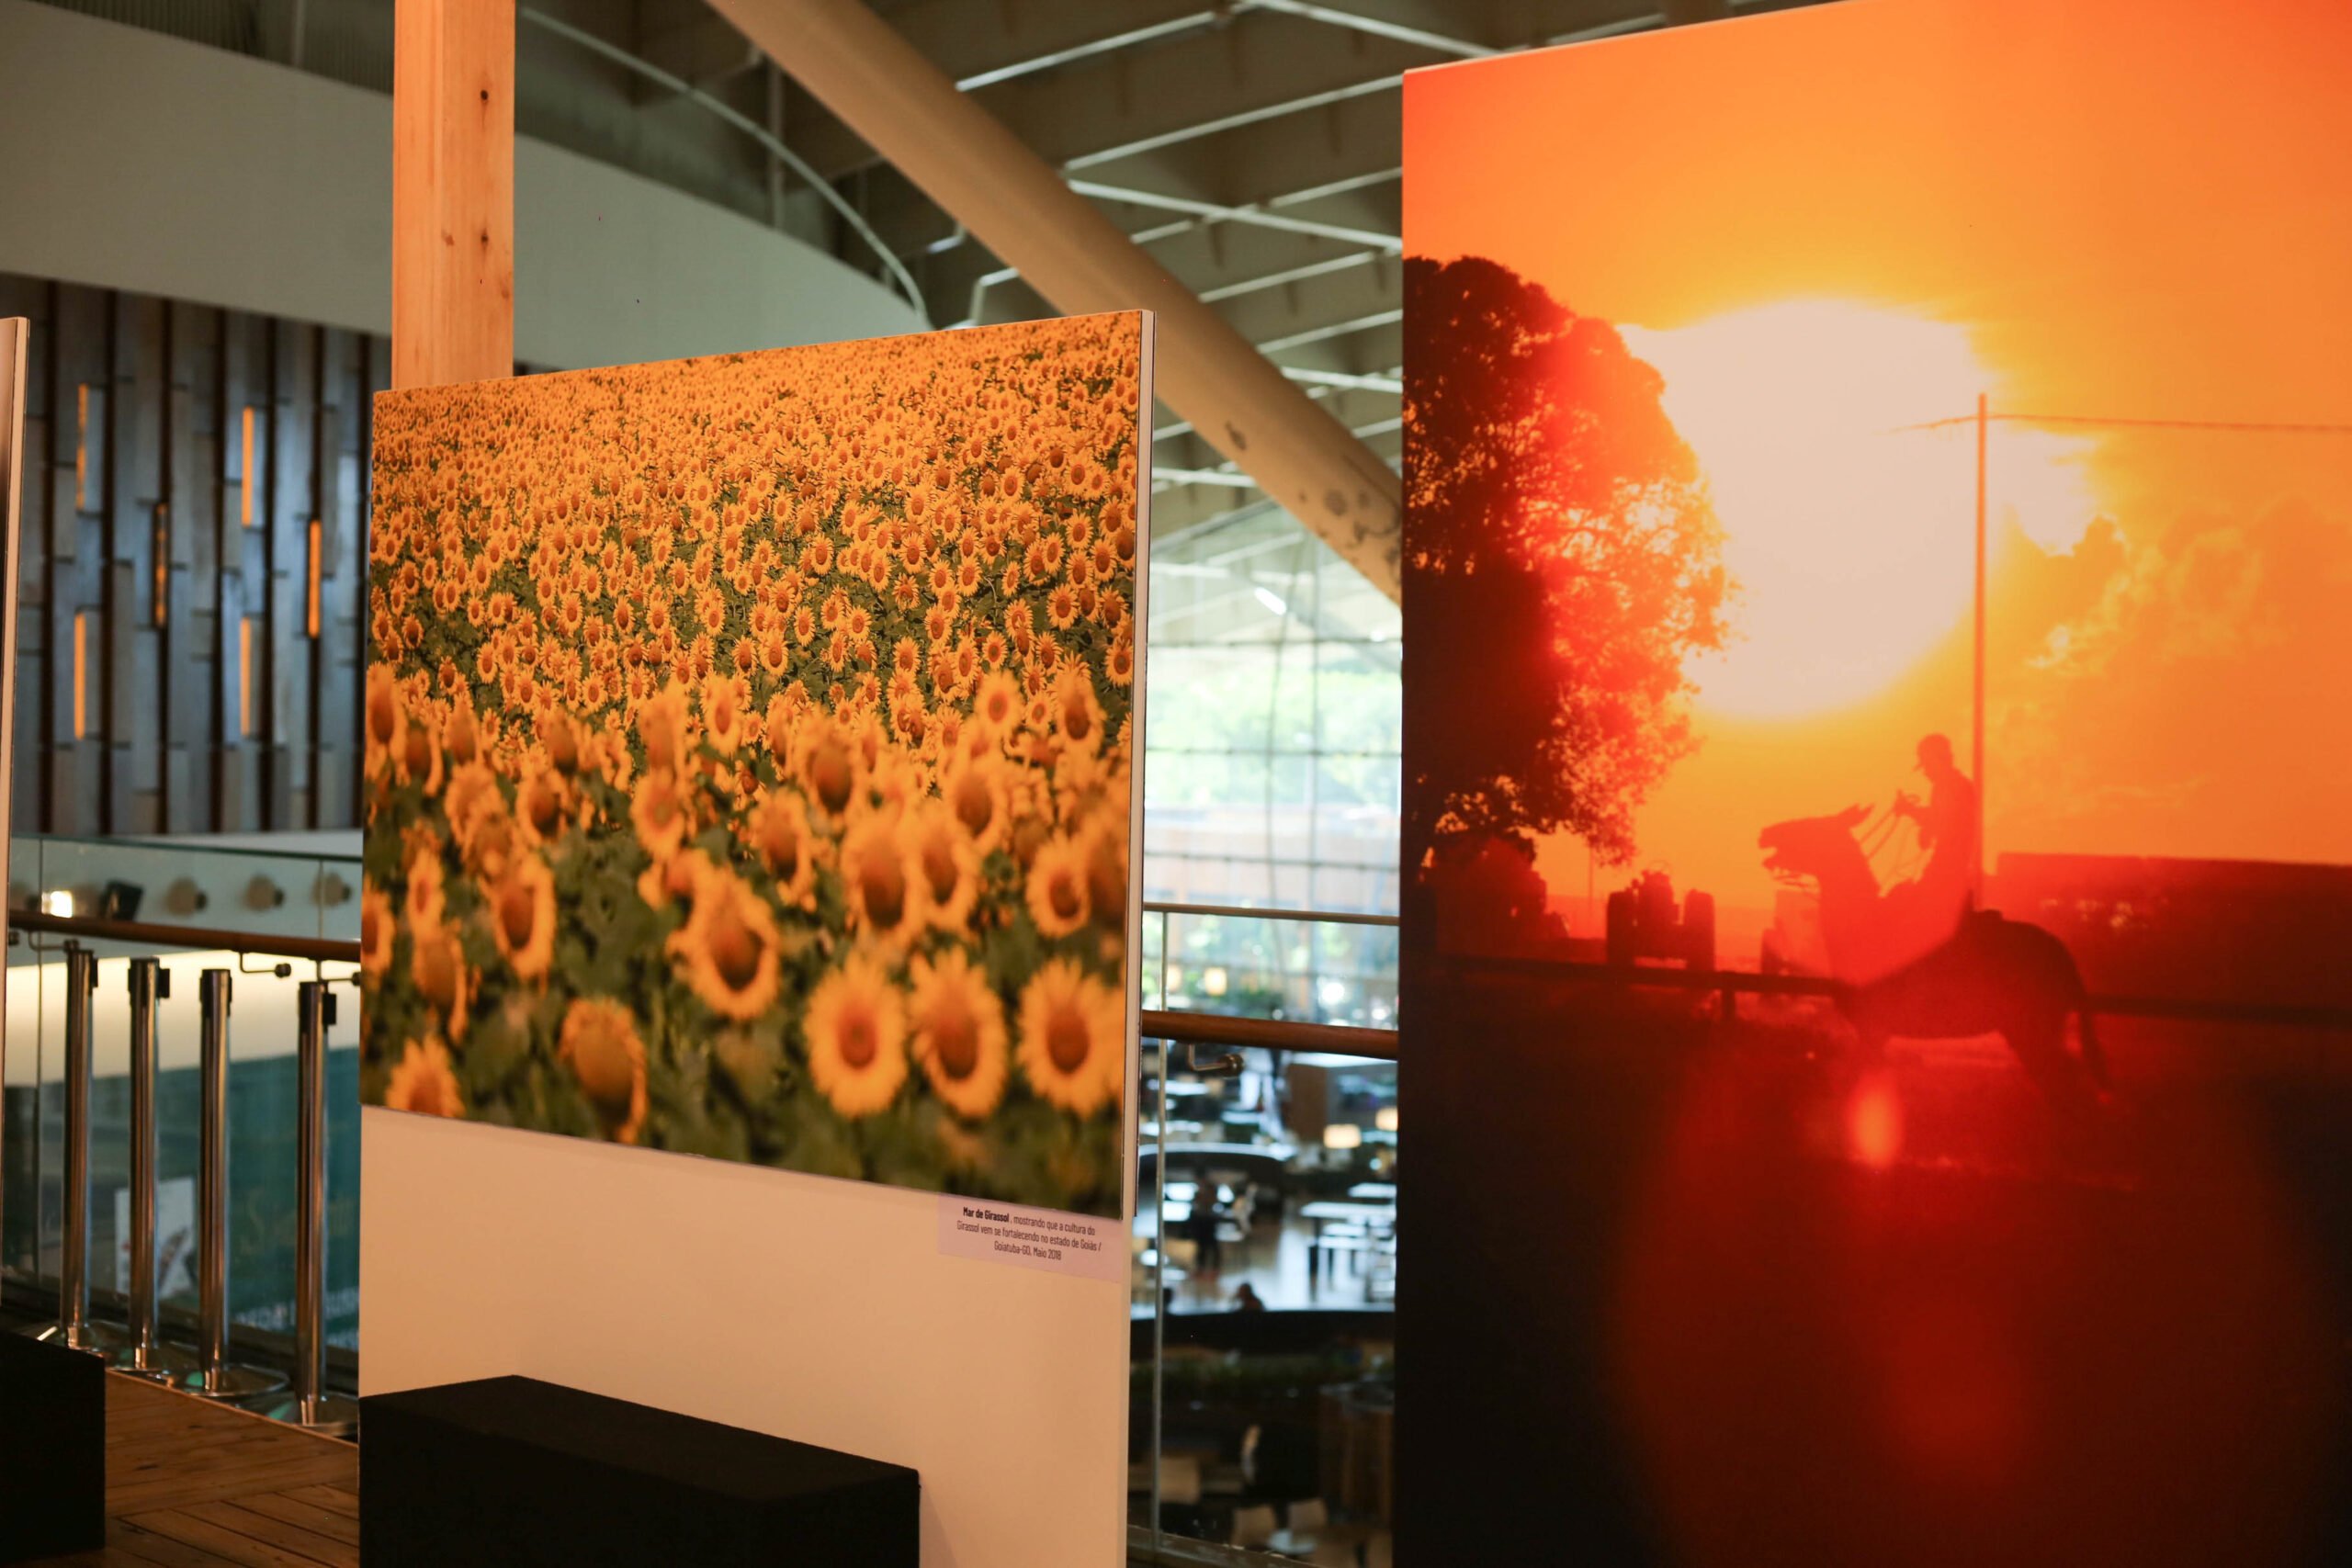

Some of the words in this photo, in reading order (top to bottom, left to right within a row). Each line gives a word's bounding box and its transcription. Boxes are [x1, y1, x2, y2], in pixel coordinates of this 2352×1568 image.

[956, 1220, 979, 1233] Girassol
[981, 1225, 993, 1235] vem
[994, 1227, 1001, 1236] se
[1002, 1227, 1040, 1243] fortalecendo
[1041, 1235, 1048, 1244] no
[1049, 1235, 1070, 1247] estado
[1071, 1237, 1080, 1248] de
[963, 1206, 974, 1217] Mar
[976, 1209, 983, 1219] de
[984, 1209, 1010, 1223] Girassol
[1013, 1216, 1046, 1228] mostrando
[1046, 1220, 1058, 1232] que
[1059, 1223, 1064, 1231] a
[1065, 1223, 1086, 1235] cultura
[1087, 1225, 1095, 1235] do
[1033, 1247, 1046, 1258] Maio
[1047, 1249, 1062, 1260] 2018
